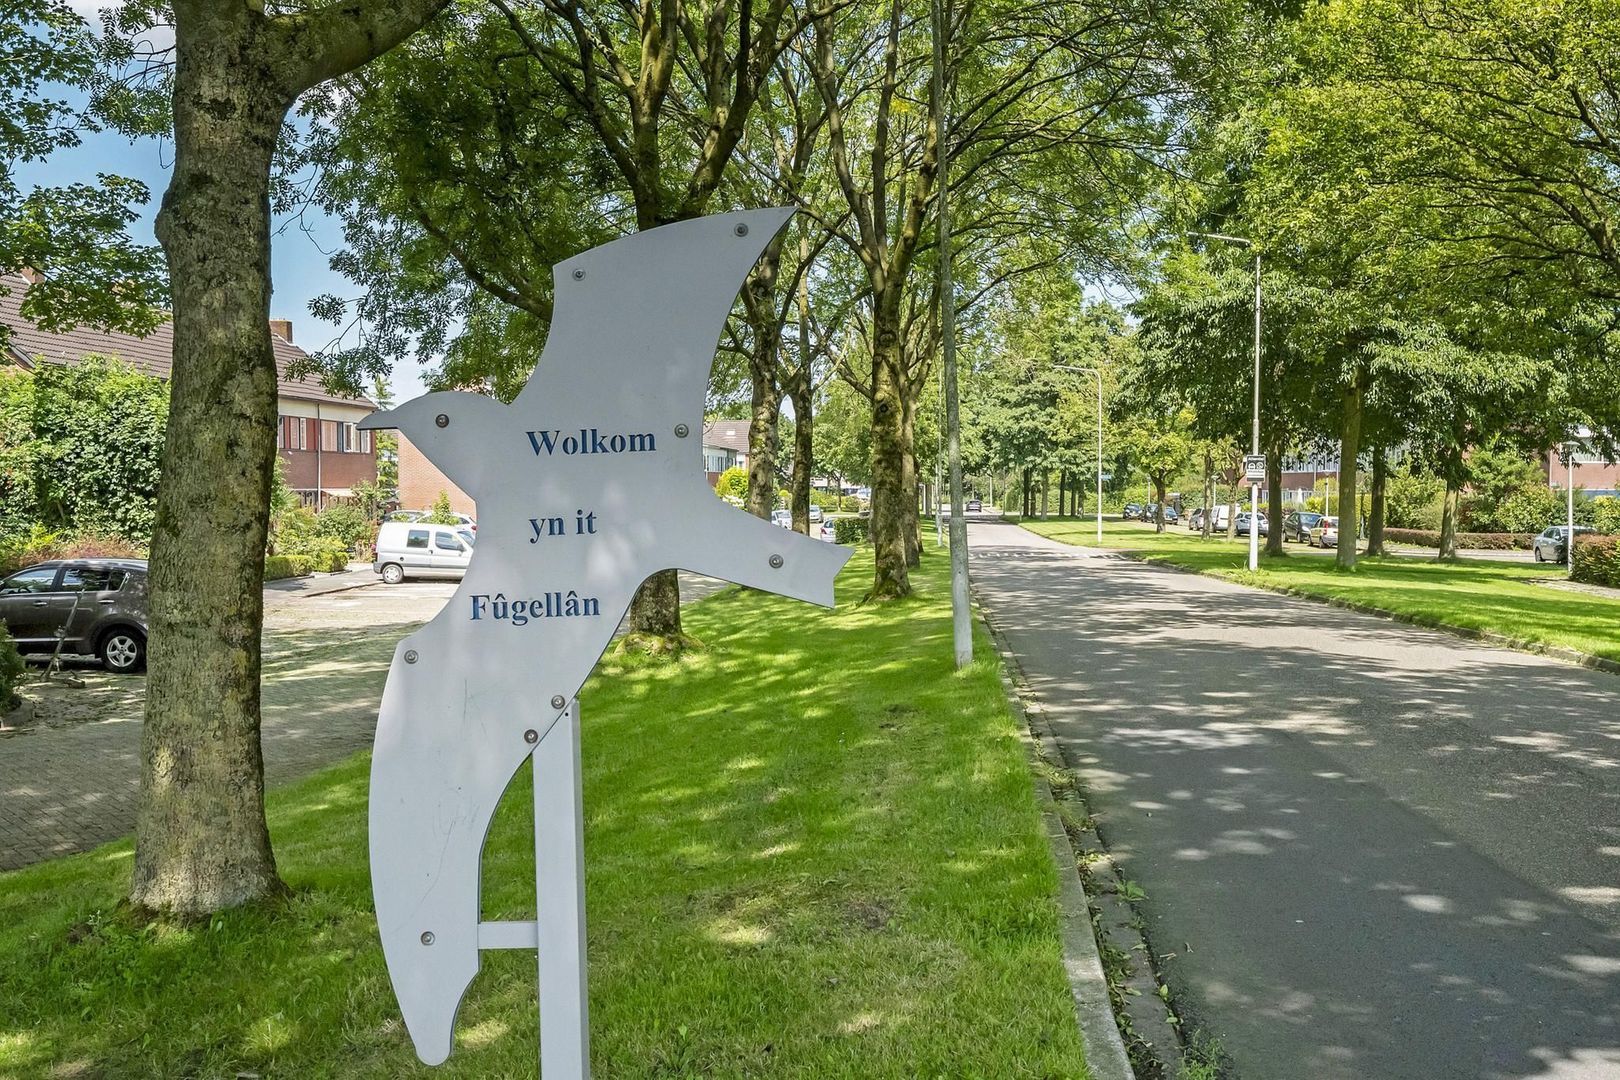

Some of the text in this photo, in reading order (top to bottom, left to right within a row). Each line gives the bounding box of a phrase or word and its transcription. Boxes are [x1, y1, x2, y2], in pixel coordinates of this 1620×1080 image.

[525, 428, 656, 457] Wolkom
[528, 508, 598, 544] yn it
[469, 590, 601, 627] Fûgellân
